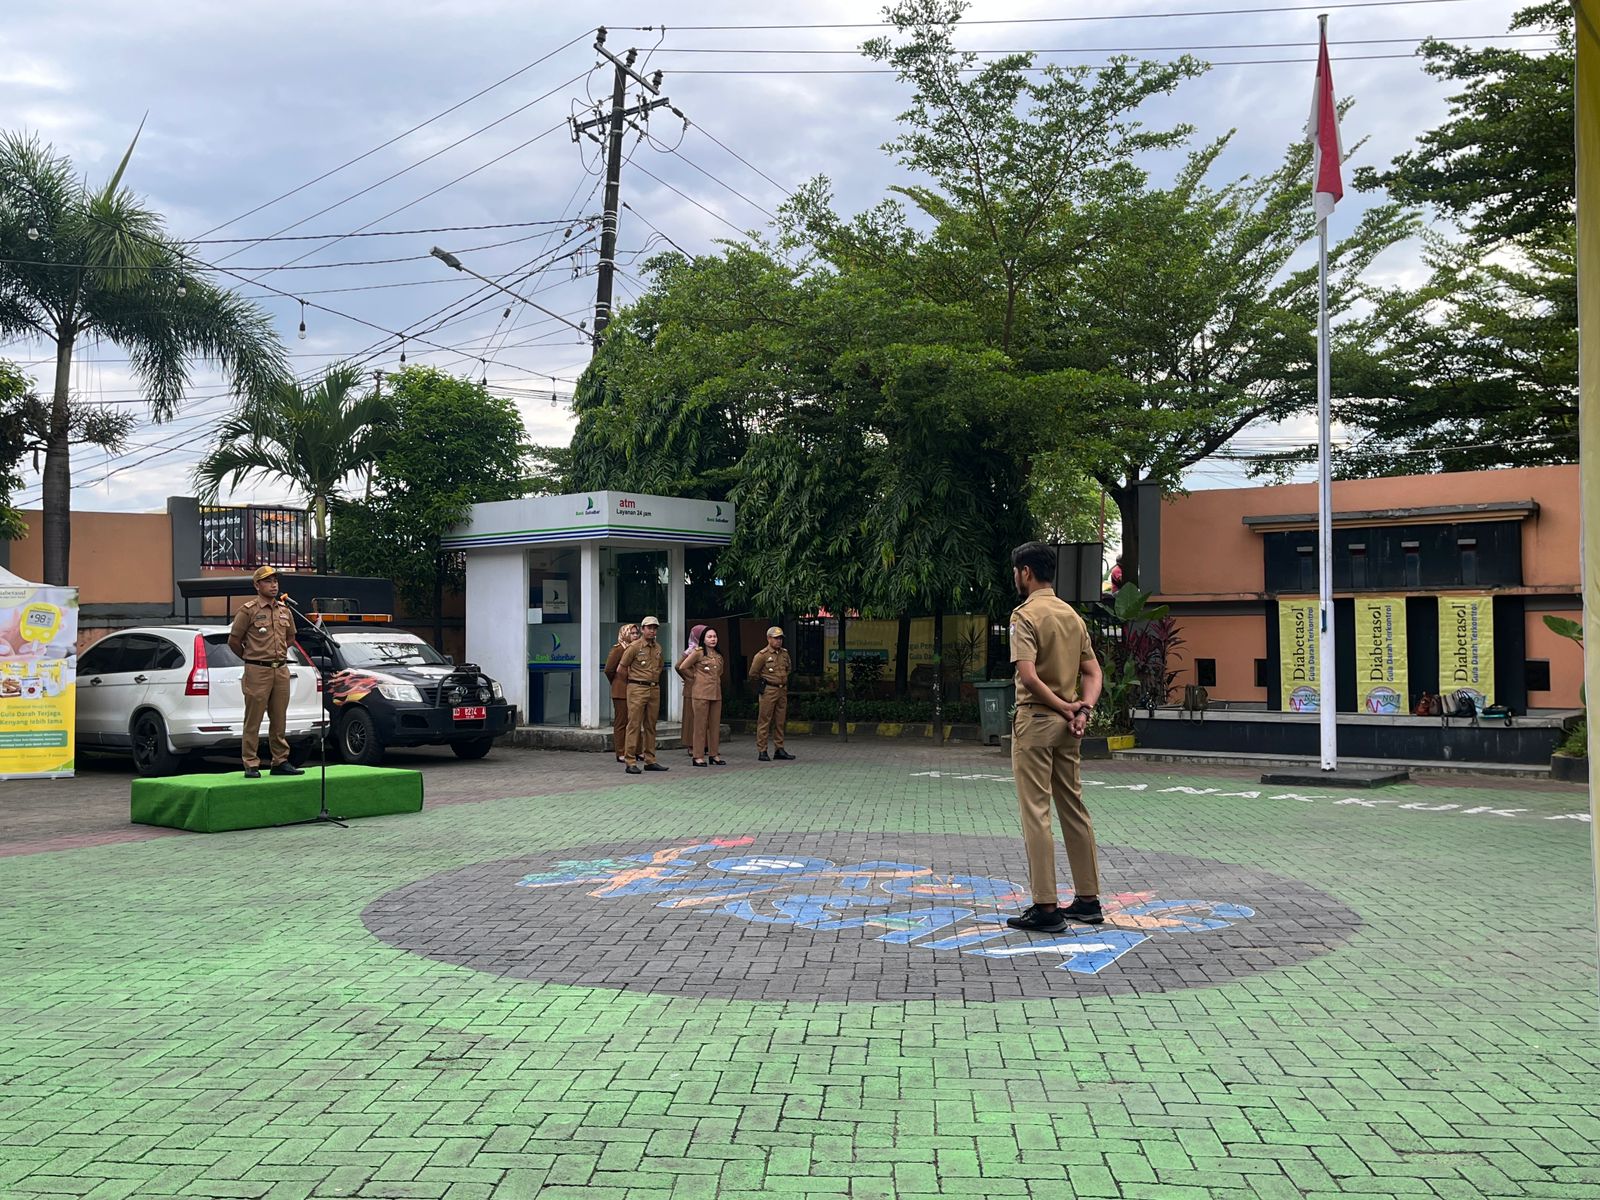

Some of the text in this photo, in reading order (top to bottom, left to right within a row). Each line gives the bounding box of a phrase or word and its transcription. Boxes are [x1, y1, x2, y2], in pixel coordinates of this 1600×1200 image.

[616, 508, 636, 516] Layanan
[619, 499, 636, 508] atm
[34, 614, 46, 623] 98
[1385, 604, 1393, 642] Terkontrol
[1470, 603, 1478, 641] Terkontrol
[1292, 607, 1306, 681] Diabetasol
[1368, 605, 1384, 682] Diabetasol
[1451, 604, 1468, 682] Diabetasol
[1386, 667, 1394, 682] Gula
[1471, 668, 1479, 683] Gula
